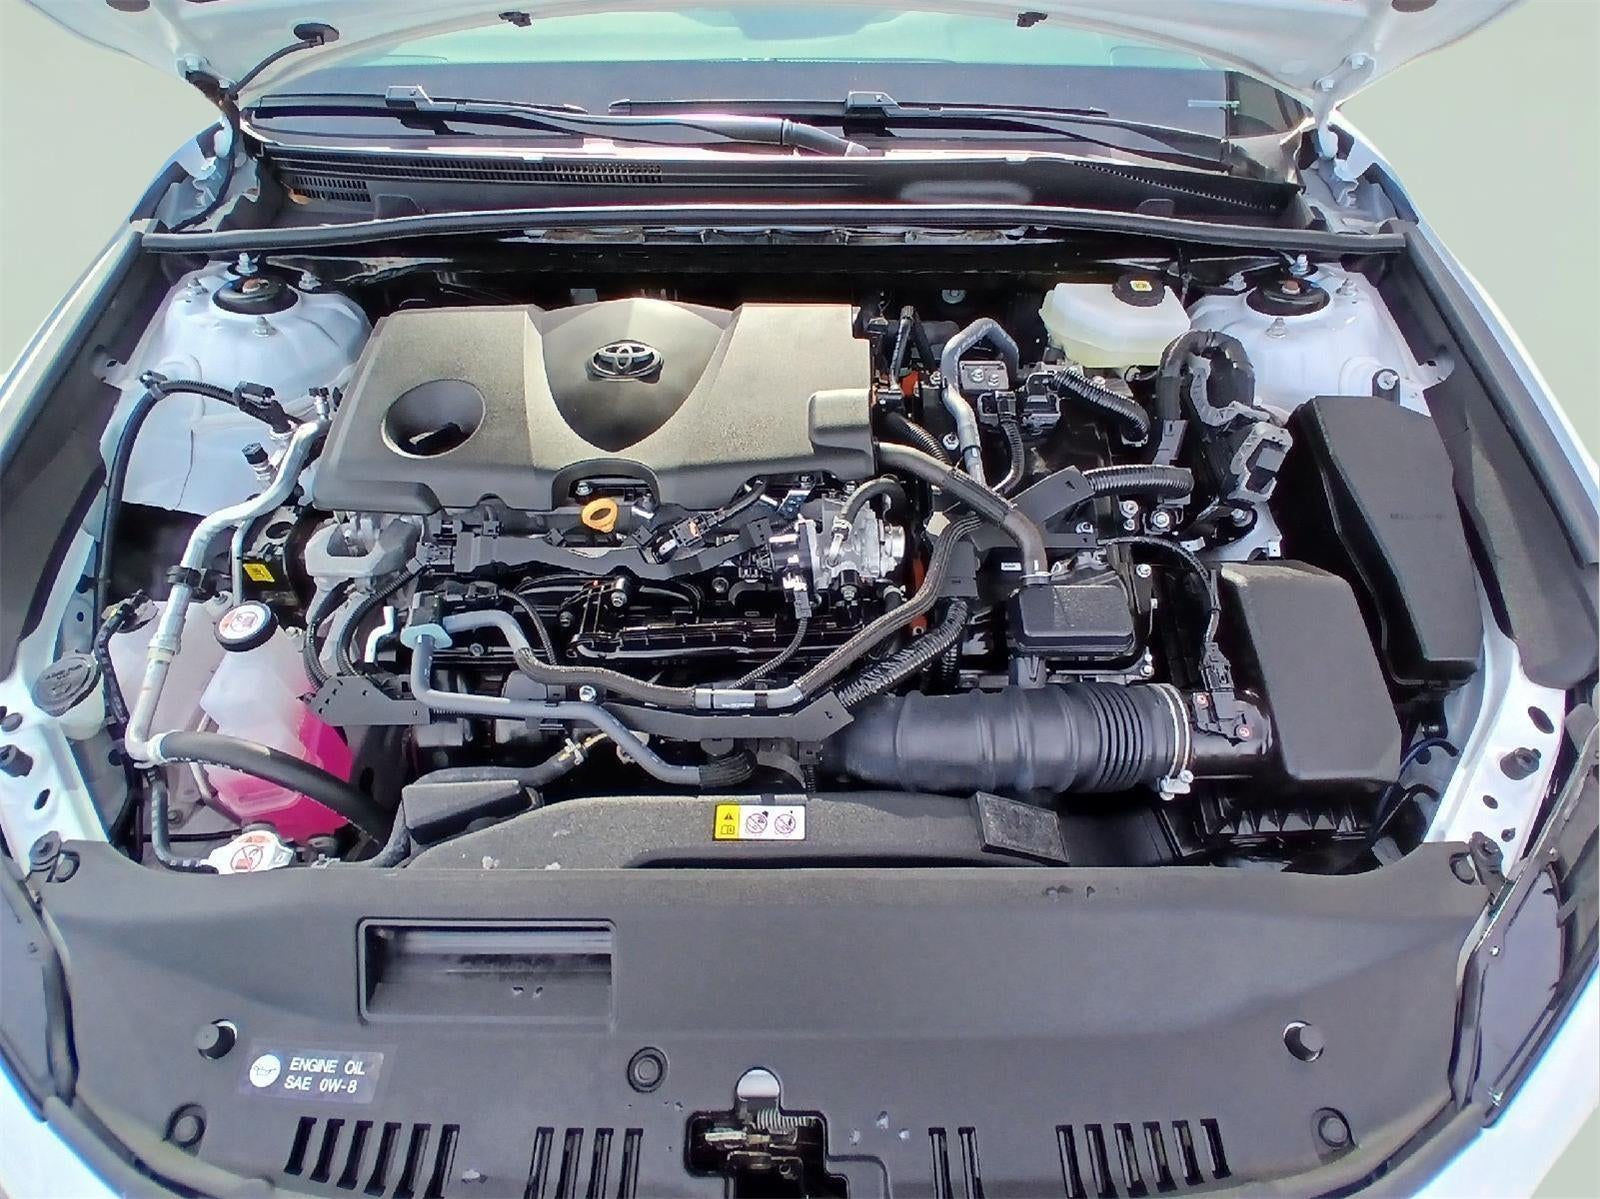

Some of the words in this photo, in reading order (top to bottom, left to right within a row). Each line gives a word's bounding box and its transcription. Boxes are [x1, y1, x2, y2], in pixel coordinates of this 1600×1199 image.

[289, 1057, 338, 1073] ENGINE
[344, 1060, 366, 1075] OIL
[284, 1075, 312, 1091] SAE
[319, 1078, 358, 1094] 0W-8
